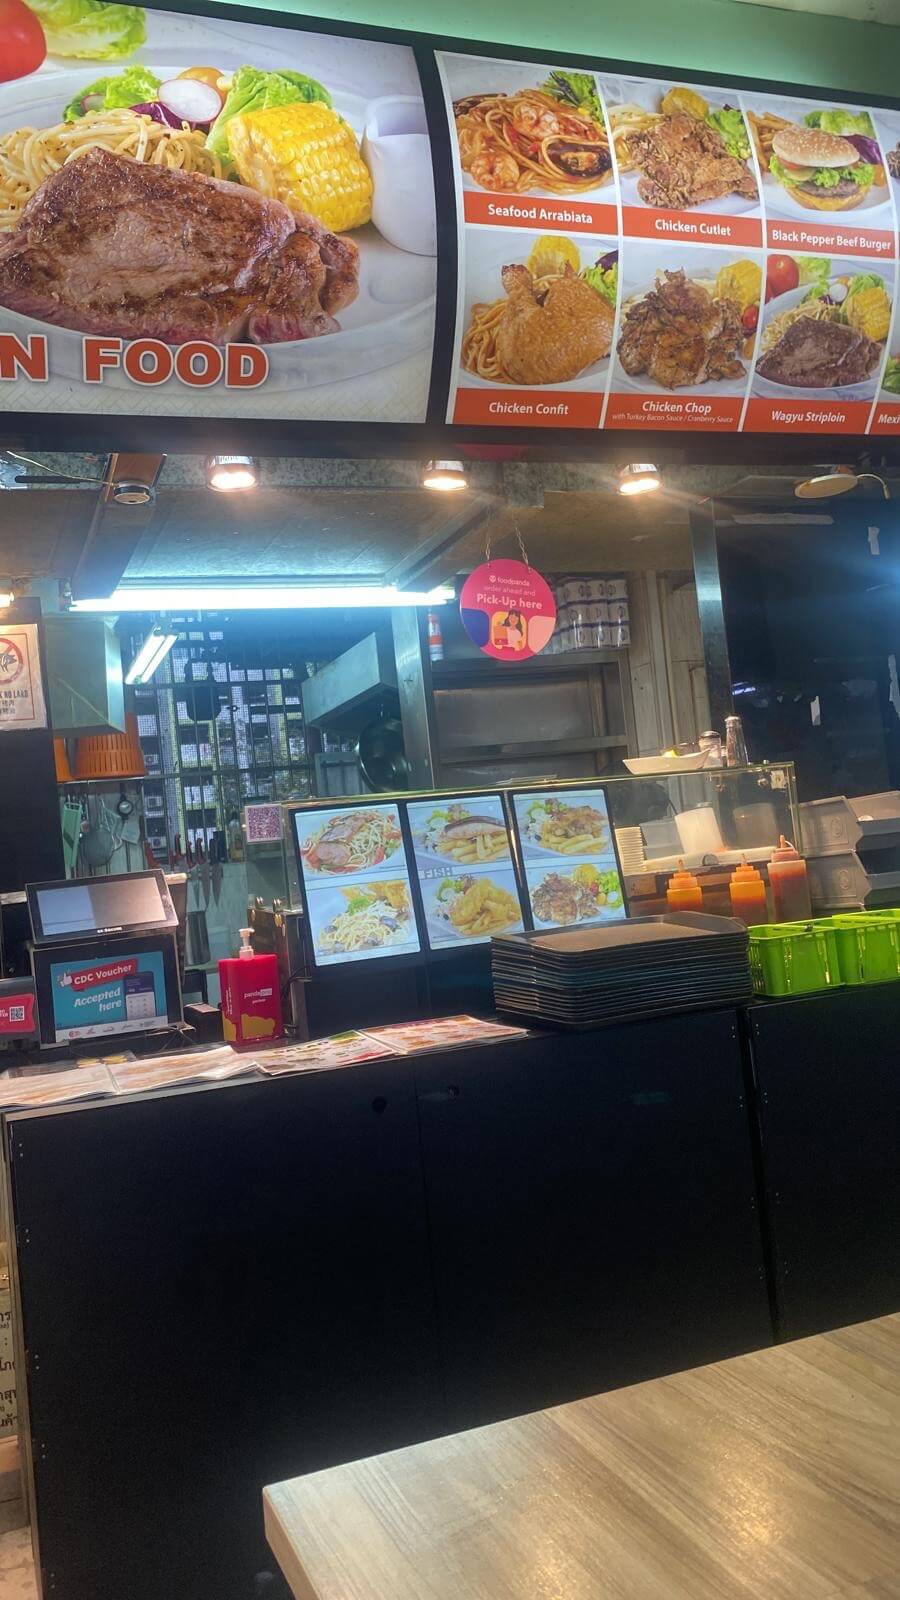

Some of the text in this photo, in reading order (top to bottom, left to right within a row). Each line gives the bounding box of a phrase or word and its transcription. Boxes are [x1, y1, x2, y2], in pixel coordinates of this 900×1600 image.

[487, 203, 593, 224] Seafood Arrabiata
[654, 218, 732, 236] Chicken Cutlet
[772, 229, 892, 252] Black Pepper Beef Burger
[0, 333, 269, 389] N FOOD
[488, 402, 569, 415] Chicken Confit
[642, 401, 712, 415] Chicken Chop
[627, 413, 646, 422] Turkey
[687, 414, 715, 424] Cranberry
[771, 411, 846, 424] Wagyu Striploin
[497, 576, 530, 587] foodpanda
[502, 587, 523, 595] ahead
[476, 593, 543, 610] Pick-Up here
[73, 964, 132, 985] CDC Voucher
[73, 987, 121, 1008] Accepted
[99, 999, 122, 1012] here
